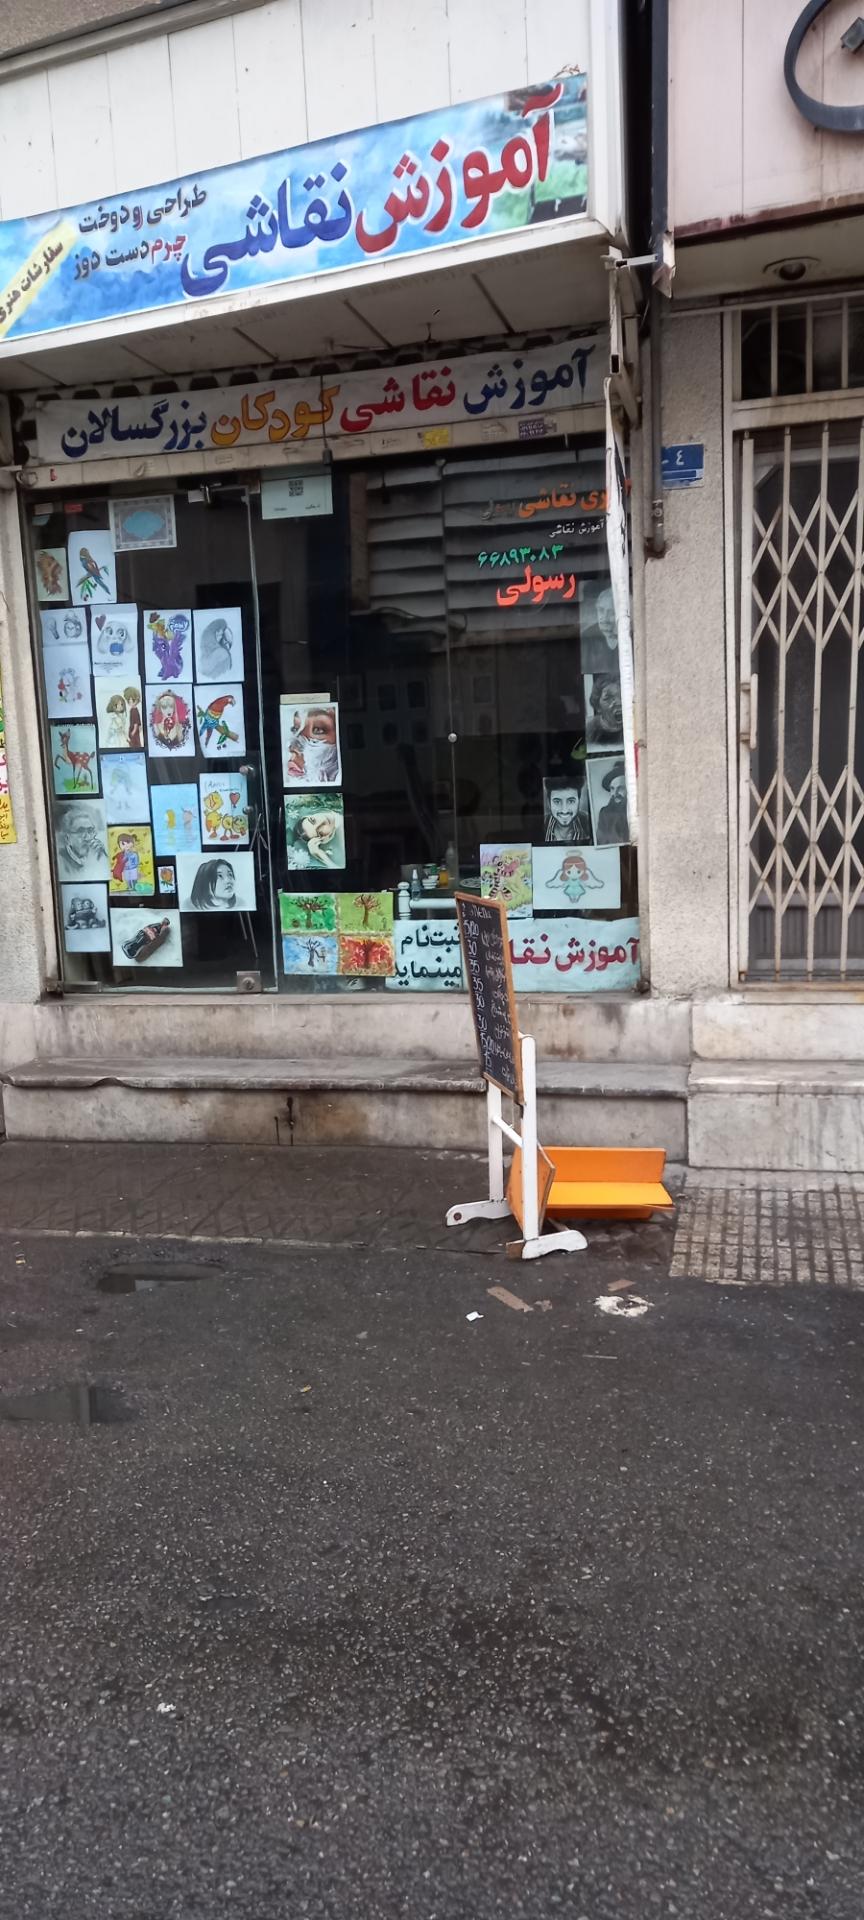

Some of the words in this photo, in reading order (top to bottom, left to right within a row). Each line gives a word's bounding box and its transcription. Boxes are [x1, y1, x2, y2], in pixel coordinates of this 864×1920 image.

[357, 83, 563, 254] آموزش
[79, 205, 130, 233] دوخت
[146, 184, 208, 225] طراحی
[181, 161, 353, 298] نقاشی
[21, 242, 64, 292] سفارشات
[74, 246, 101, 281] دوز
[105, 240, 149, 267] دست
[151, 235, 186, 265] چرم
[463, 344, 597, 415] آموزش
[210, 384, 342, 447] کودکان
[340, 366, 456, 432] نقاشی
[61, 398, 208, 458] بزرگسالان
[518, 483, 576, 518] نقاشی
[549, 522, 576, 539] نقاشی
[578, 518, 605, 535] آموزش
[496, 564, 576, 609] رسولی
[401, 924, 430, 955] نام
[508, 933, 551, 965] نقا
[555, 937, 640, 972] آموزش
